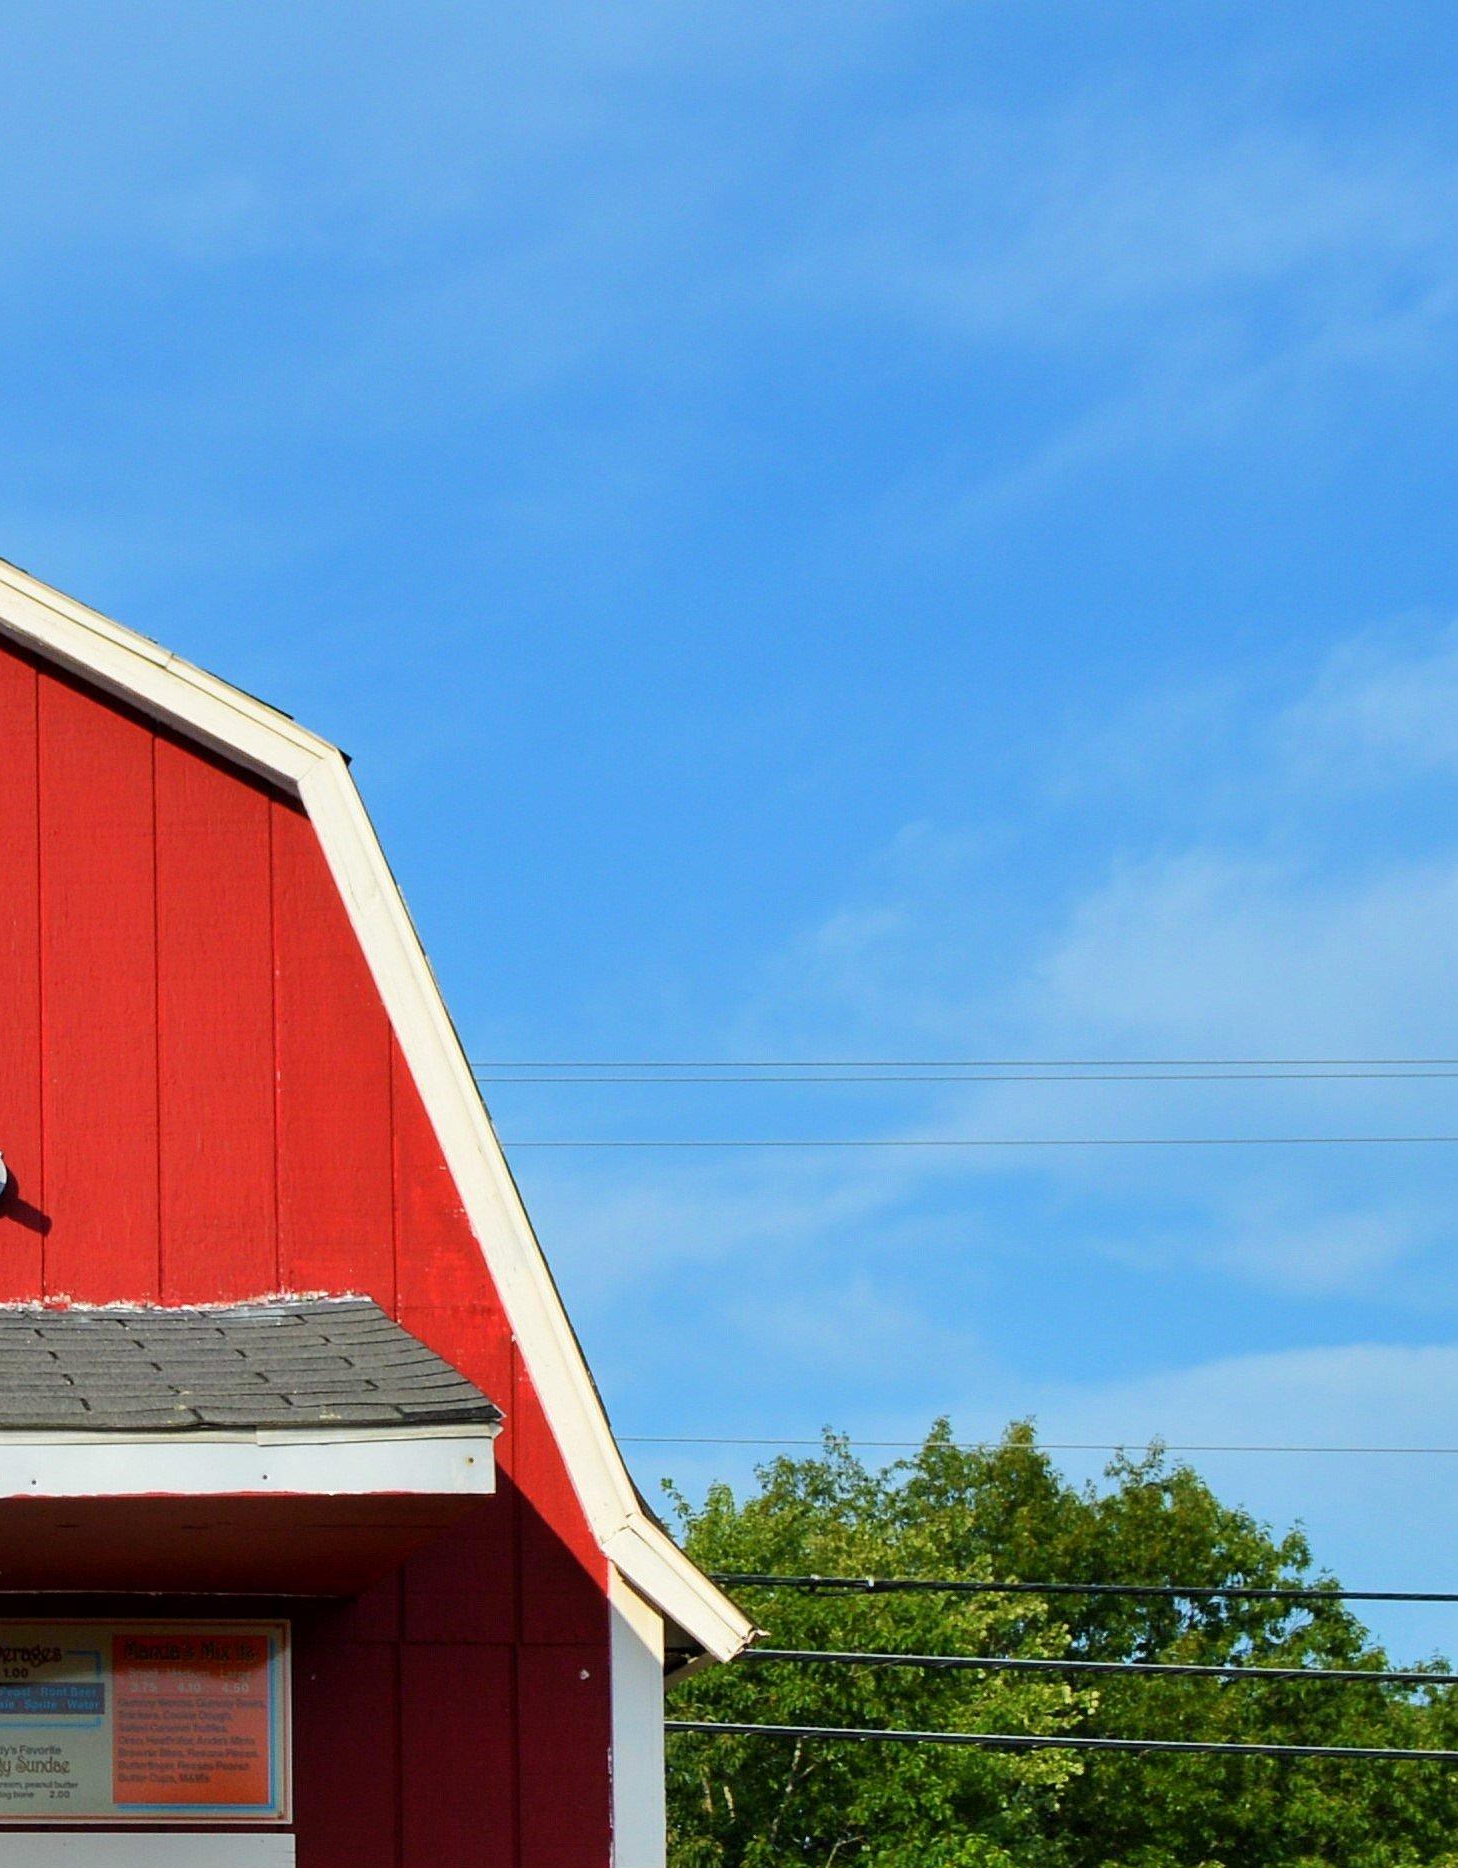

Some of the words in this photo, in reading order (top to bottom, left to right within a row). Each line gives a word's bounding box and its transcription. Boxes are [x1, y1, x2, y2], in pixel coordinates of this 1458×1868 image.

[2, 1667, 30, 1679] 1.00
[20, 1745, 62, 1756] Favorite
[15, 1755, 71, 1775] Sundae
[55, 1782, 80, 1790] butter
[49, 1790, 71, 1800] 2.00
